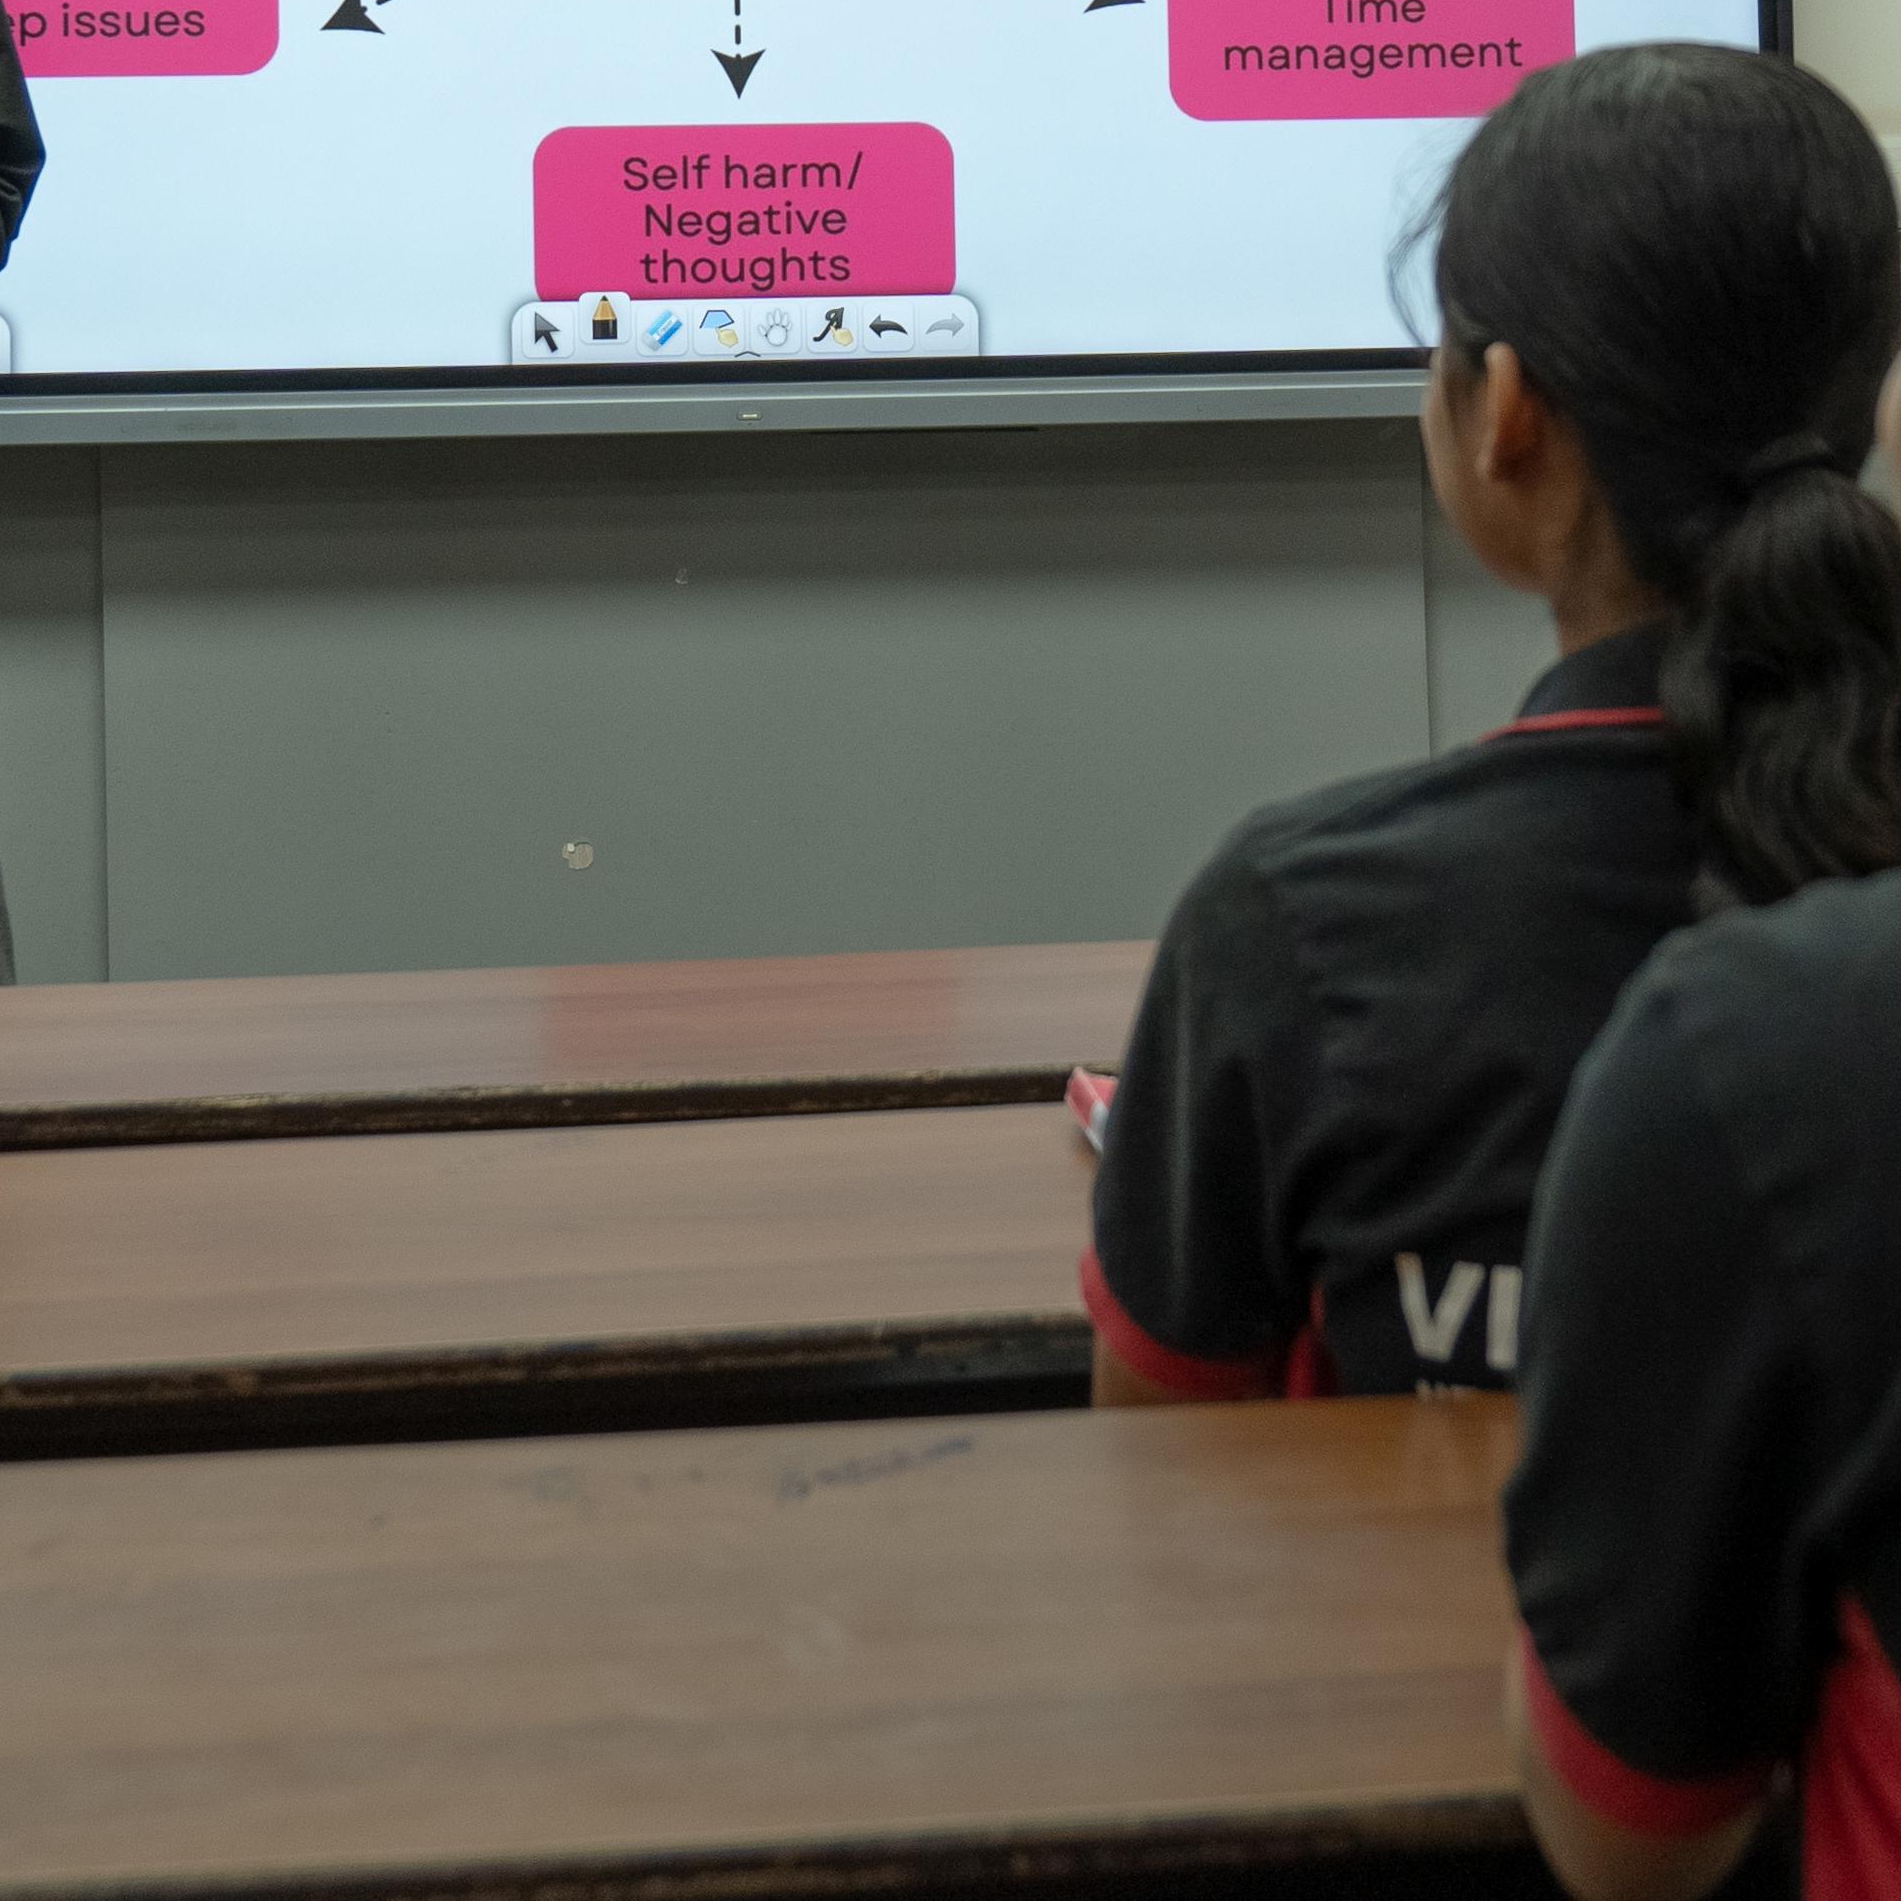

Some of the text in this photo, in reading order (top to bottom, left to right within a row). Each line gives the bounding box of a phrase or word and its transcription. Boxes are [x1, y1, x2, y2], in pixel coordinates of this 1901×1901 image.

[61, 2, 205, 38] issues
[1224, 37, 1524, 79] management
[623, 151, 863, 192] Self harm/
[644, 200, 848, 246] Negative
[639, 248, 852, 291] thoughts
